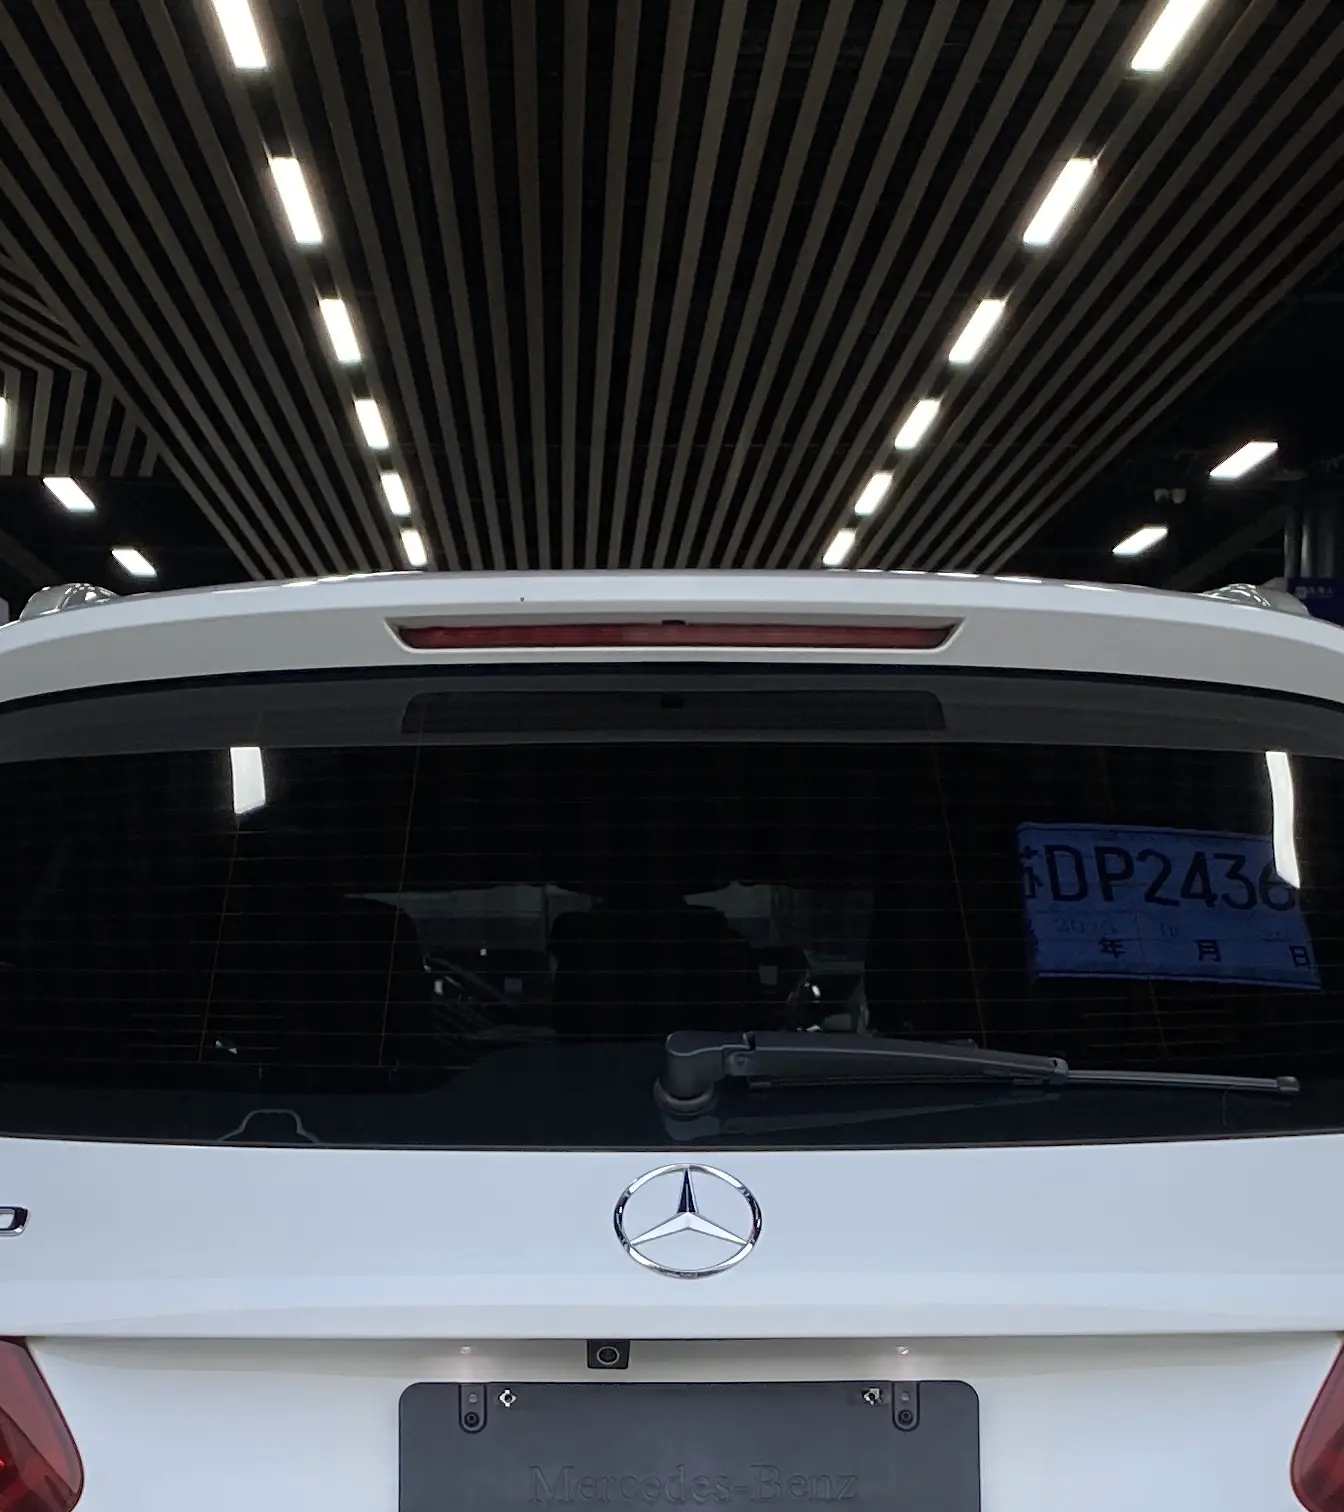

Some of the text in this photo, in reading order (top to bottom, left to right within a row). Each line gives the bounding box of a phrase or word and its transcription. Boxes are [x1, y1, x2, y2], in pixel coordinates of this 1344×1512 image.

[1099, 935, 1313, 970] 年 月 日
[529, 1464, 859, 1505] Mercedes-Benz
